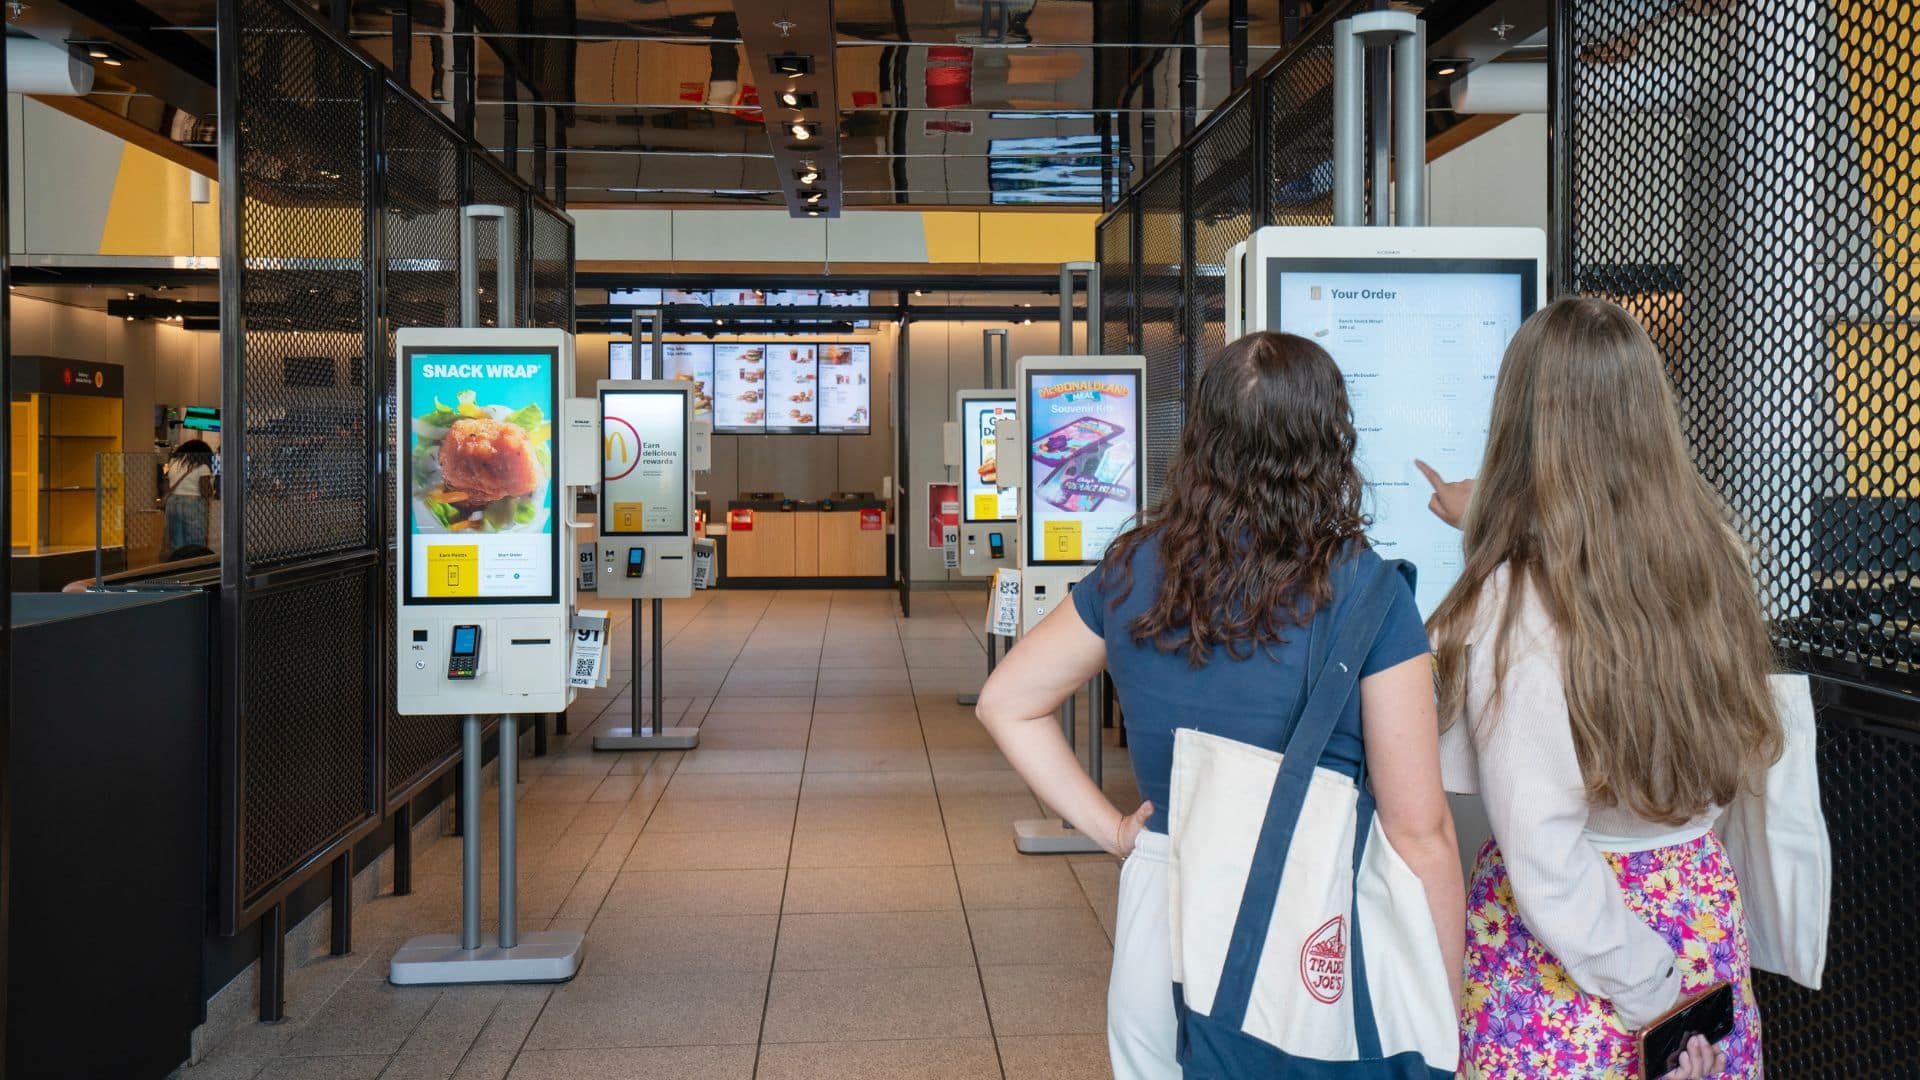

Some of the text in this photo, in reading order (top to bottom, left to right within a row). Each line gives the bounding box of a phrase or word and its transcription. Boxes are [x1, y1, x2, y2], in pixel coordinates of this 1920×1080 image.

[1331, 289, 1397, 299] Your Order
[422, 364, 484, 378] SNACK
[1073, 391, 1095, 401] MEAL
[1051, 403, 1094, 414] Souvenir
[580, 552, 593, 562] 81
[1000, 581, 1019, 595] 83
[578, 629, 600, 642] 91
[1309, 957, 1344, 974] TRADE
[1313, 975, 1343, 990] JOE'S
